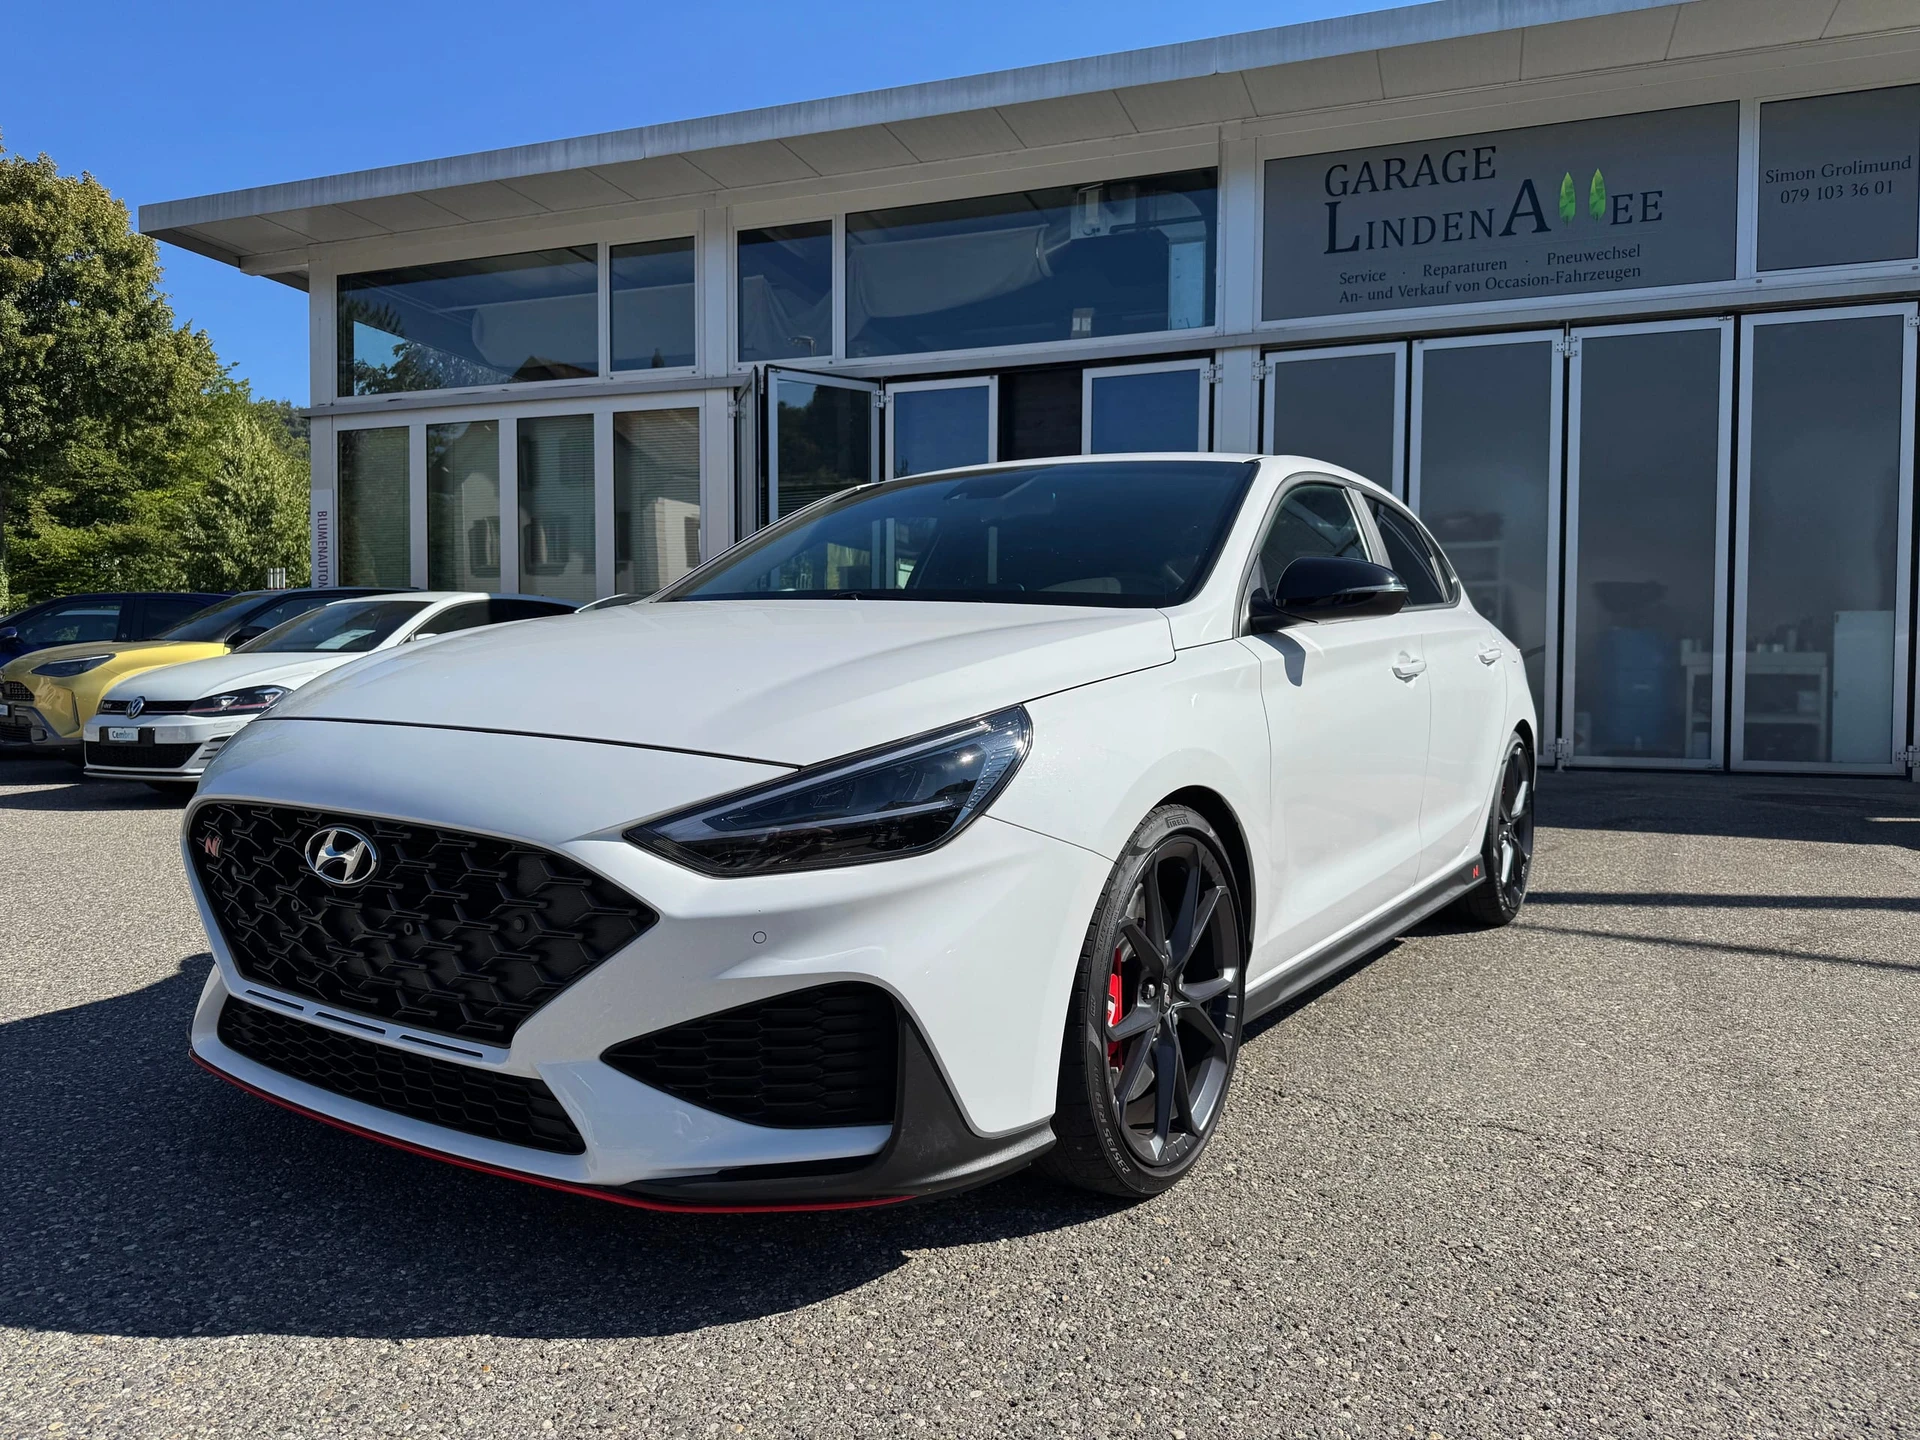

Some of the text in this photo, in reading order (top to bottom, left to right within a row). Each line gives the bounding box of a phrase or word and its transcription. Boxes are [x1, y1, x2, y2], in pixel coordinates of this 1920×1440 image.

[1324, 146, 1497, 196] GARAGE
[1765, 155, 1912, 184] Simon Grolimund
[1780, 180, 1893, 204] 079 103 36 01
[1339, 244, 1641, 285] Service Reparaturen Pneuwechsel
[1339, 266, 1641, 304] An- und Verkauf von Occasion-Fahrzeugen
[1164, 814, 1189, 828] PIRELLI
